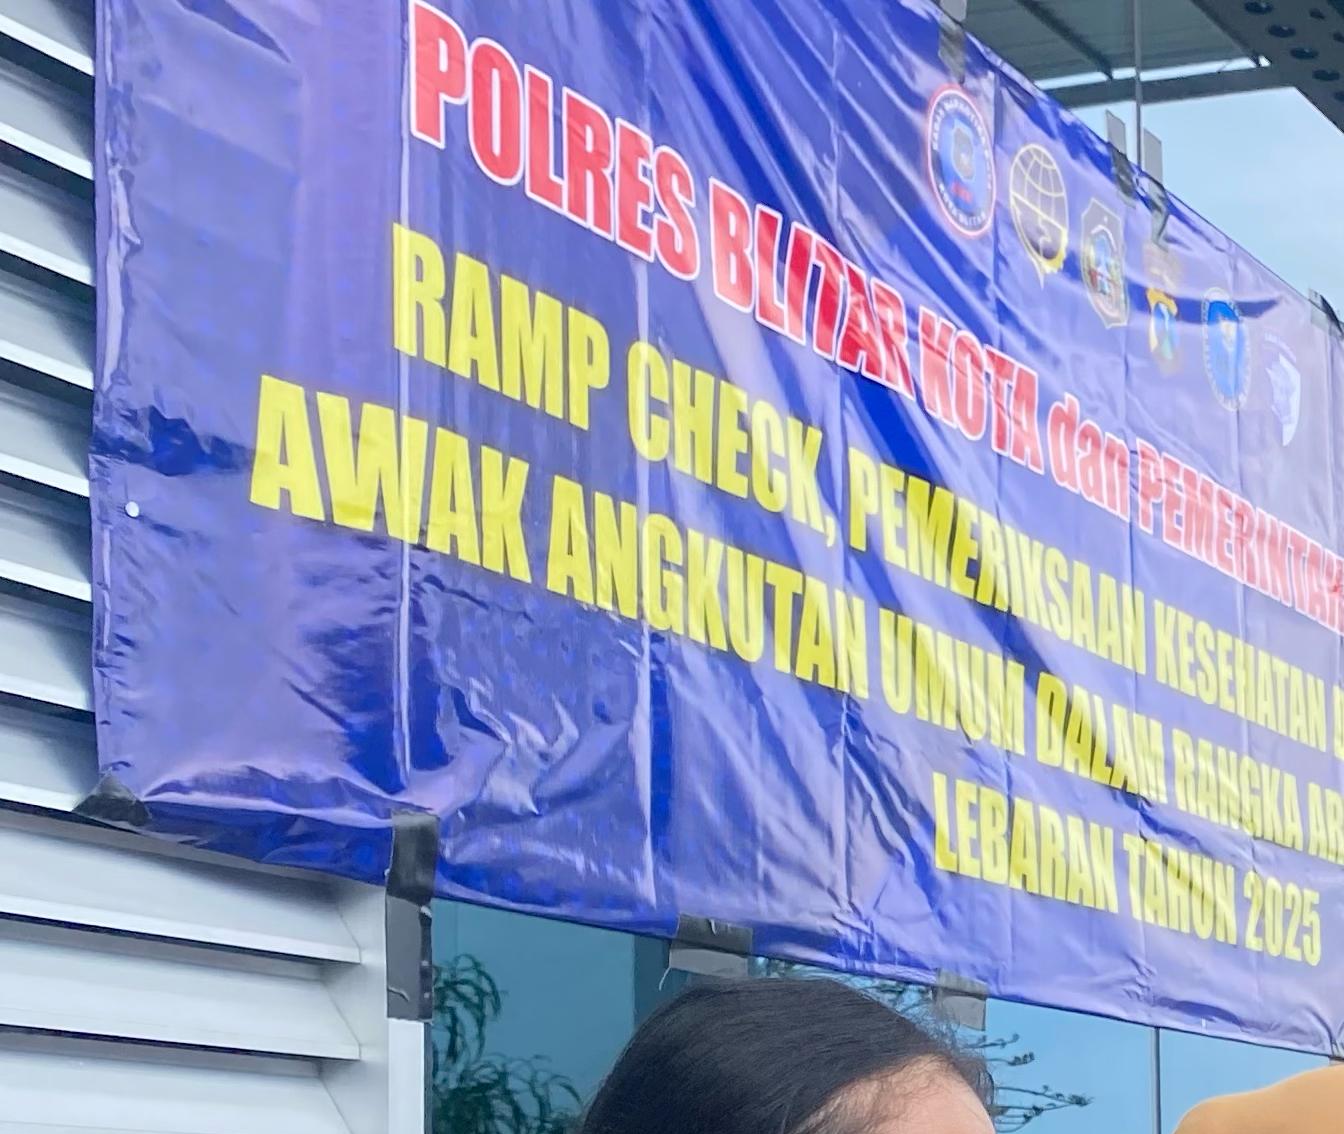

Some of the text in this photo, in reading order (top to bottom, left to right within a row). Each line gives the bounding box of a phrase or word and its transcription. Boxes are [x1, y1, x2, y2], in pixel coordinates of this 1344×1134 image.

[392, 223, 610, 431] RAMP
[626, 341, 838, 549] CHECK,
[848, 446, 1147, 677] PEMERIKSAAN
[1153, 599, 1327, 754] KESEHATAN
[408, 0, 700, 281] POLRES
[708, 176, 914, 400] BLITAR
[918, 305, 1044, 476] KOTA
[1047, 393, 1130, 523] dan
[248, 374, 532, 584] AWAK
[545, 474, 870, 700] ANGKUTAN
[878, 607, 1026, 757] UMUM
[1036, 671, 1169, 804] DALAM
[1172, 718, 1303, 851] RANGKA
[932, 772, 1321, 967] LEBARAN TAHUN 2025
